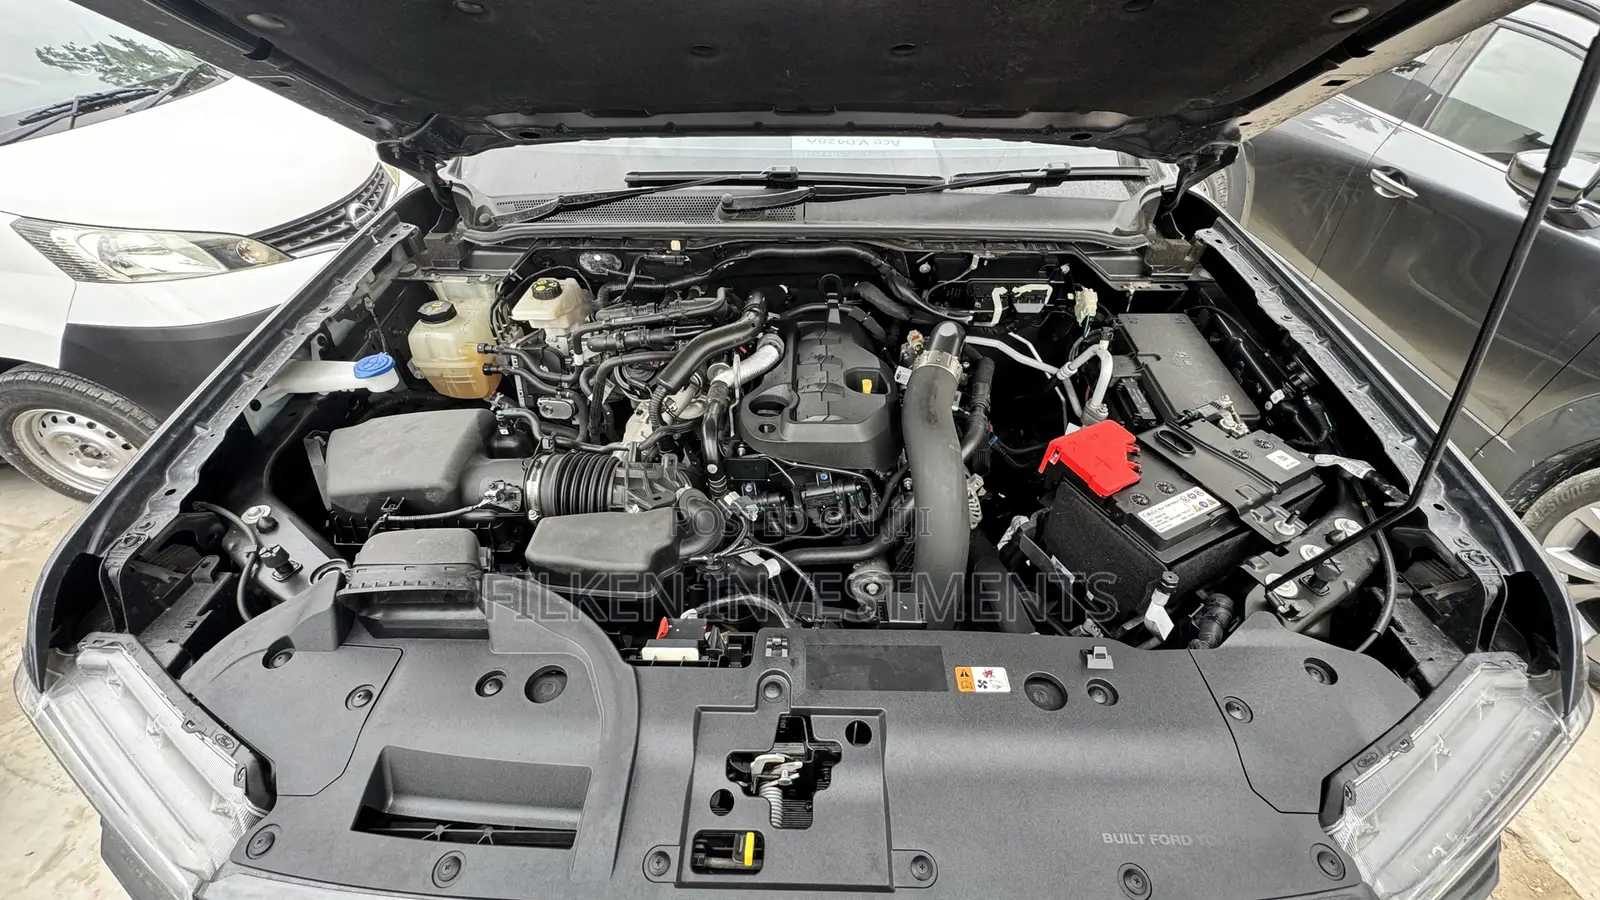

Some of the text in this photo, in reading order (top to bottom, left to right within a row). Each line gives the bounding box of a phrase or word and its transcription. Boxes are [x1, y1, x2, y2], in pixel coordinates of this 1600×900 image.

[873, 139, 901, 147] Ace
[1102, 832, 1145, 845] BUILT
[1150, 834, 1193, 846] FORD
